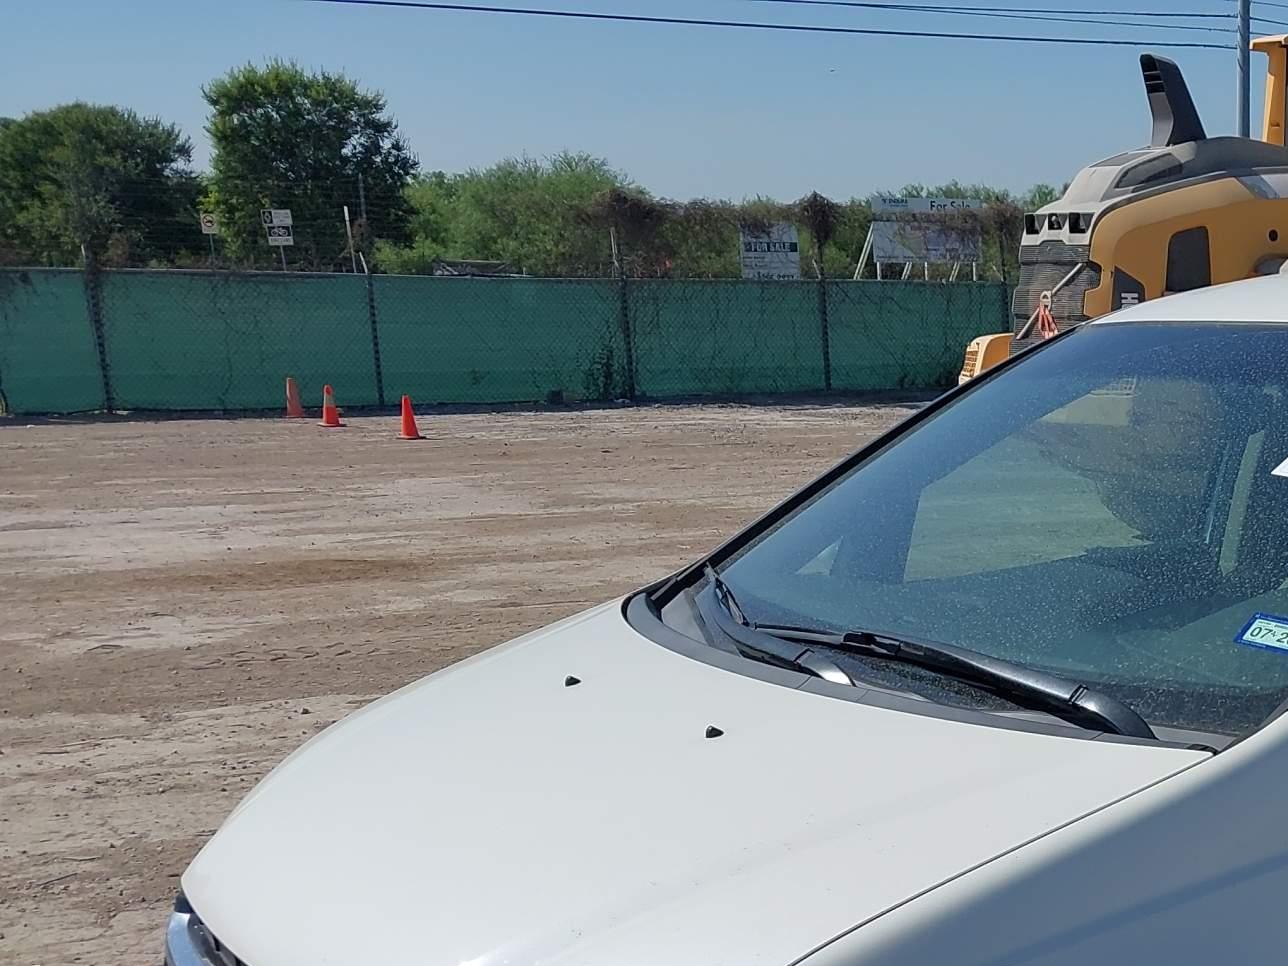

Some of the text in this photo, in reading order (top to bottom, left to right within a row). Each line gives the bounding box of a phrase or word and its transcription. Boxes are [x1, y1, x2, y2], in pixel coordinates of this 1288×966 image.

[930, 200, 947, 211] For
[751, 242, 791, 252] FOR SALE
[1249, 626, 1273, 639] 07
